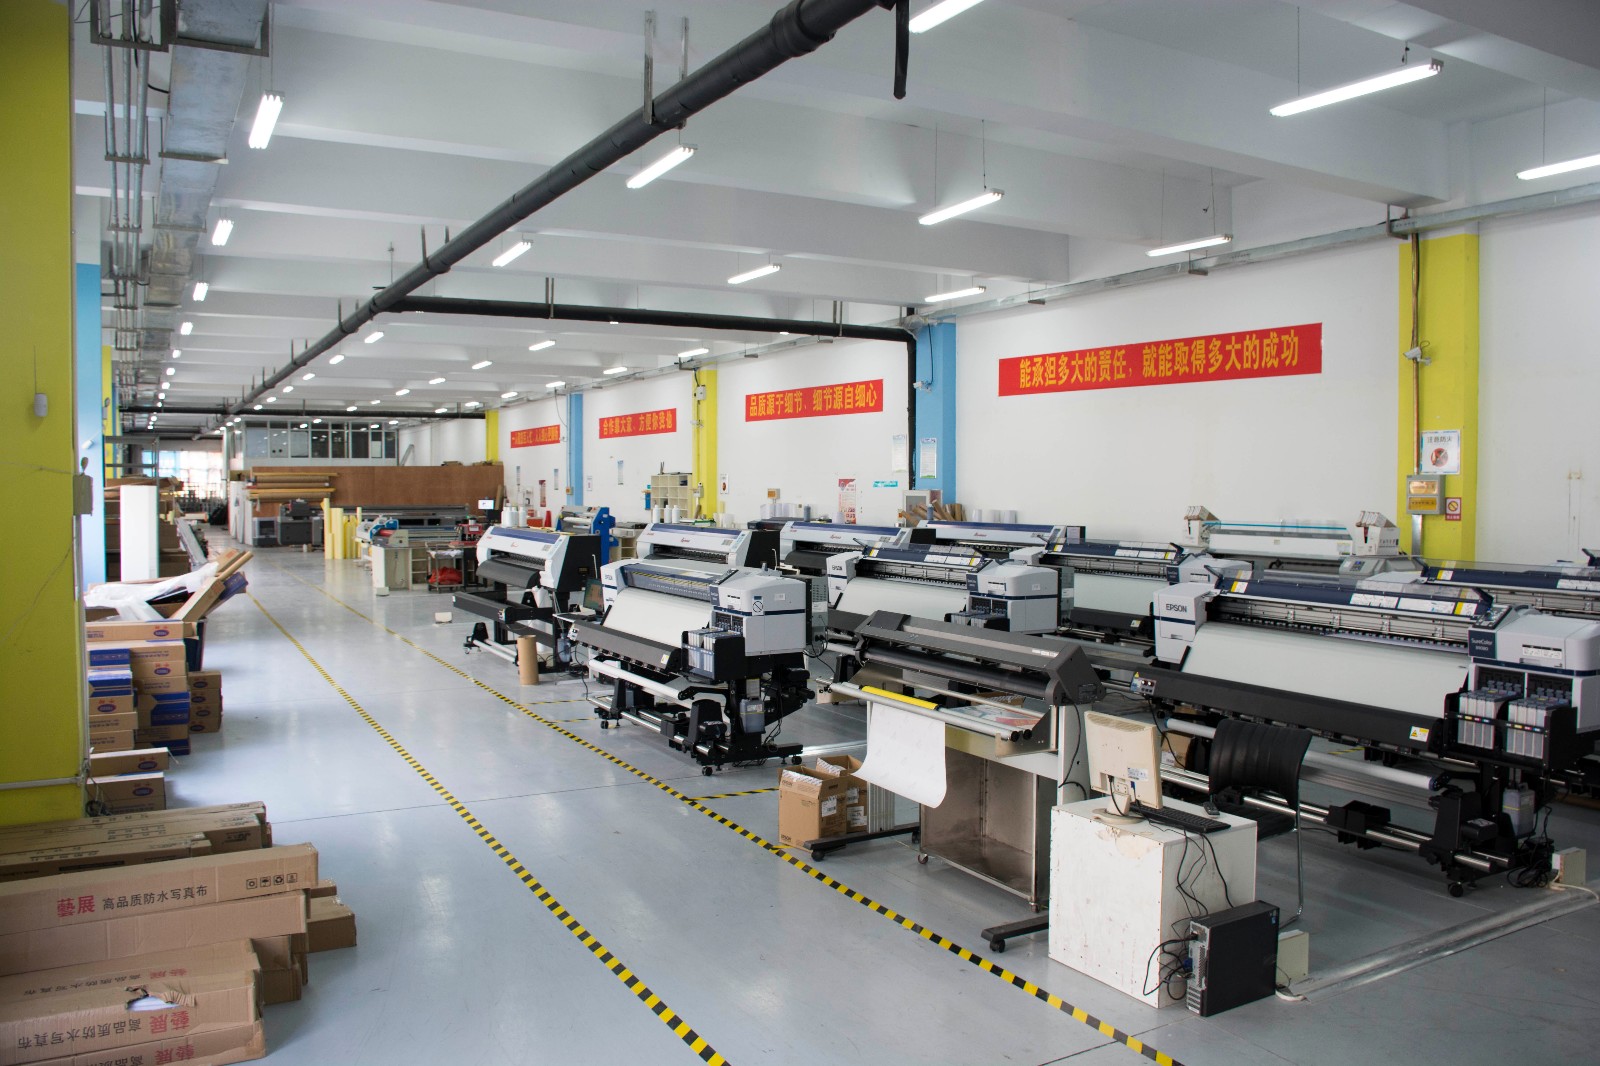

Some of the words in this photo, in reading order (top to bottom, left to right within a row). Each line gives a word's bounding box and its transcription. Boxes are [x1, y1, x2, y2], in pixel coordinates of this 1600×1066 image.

[1165, 603, 1188, 613] EPSON
[1470, 637, 1493, 645] SureColor
[102, 885, 208, 910] 高品质防水写真布
